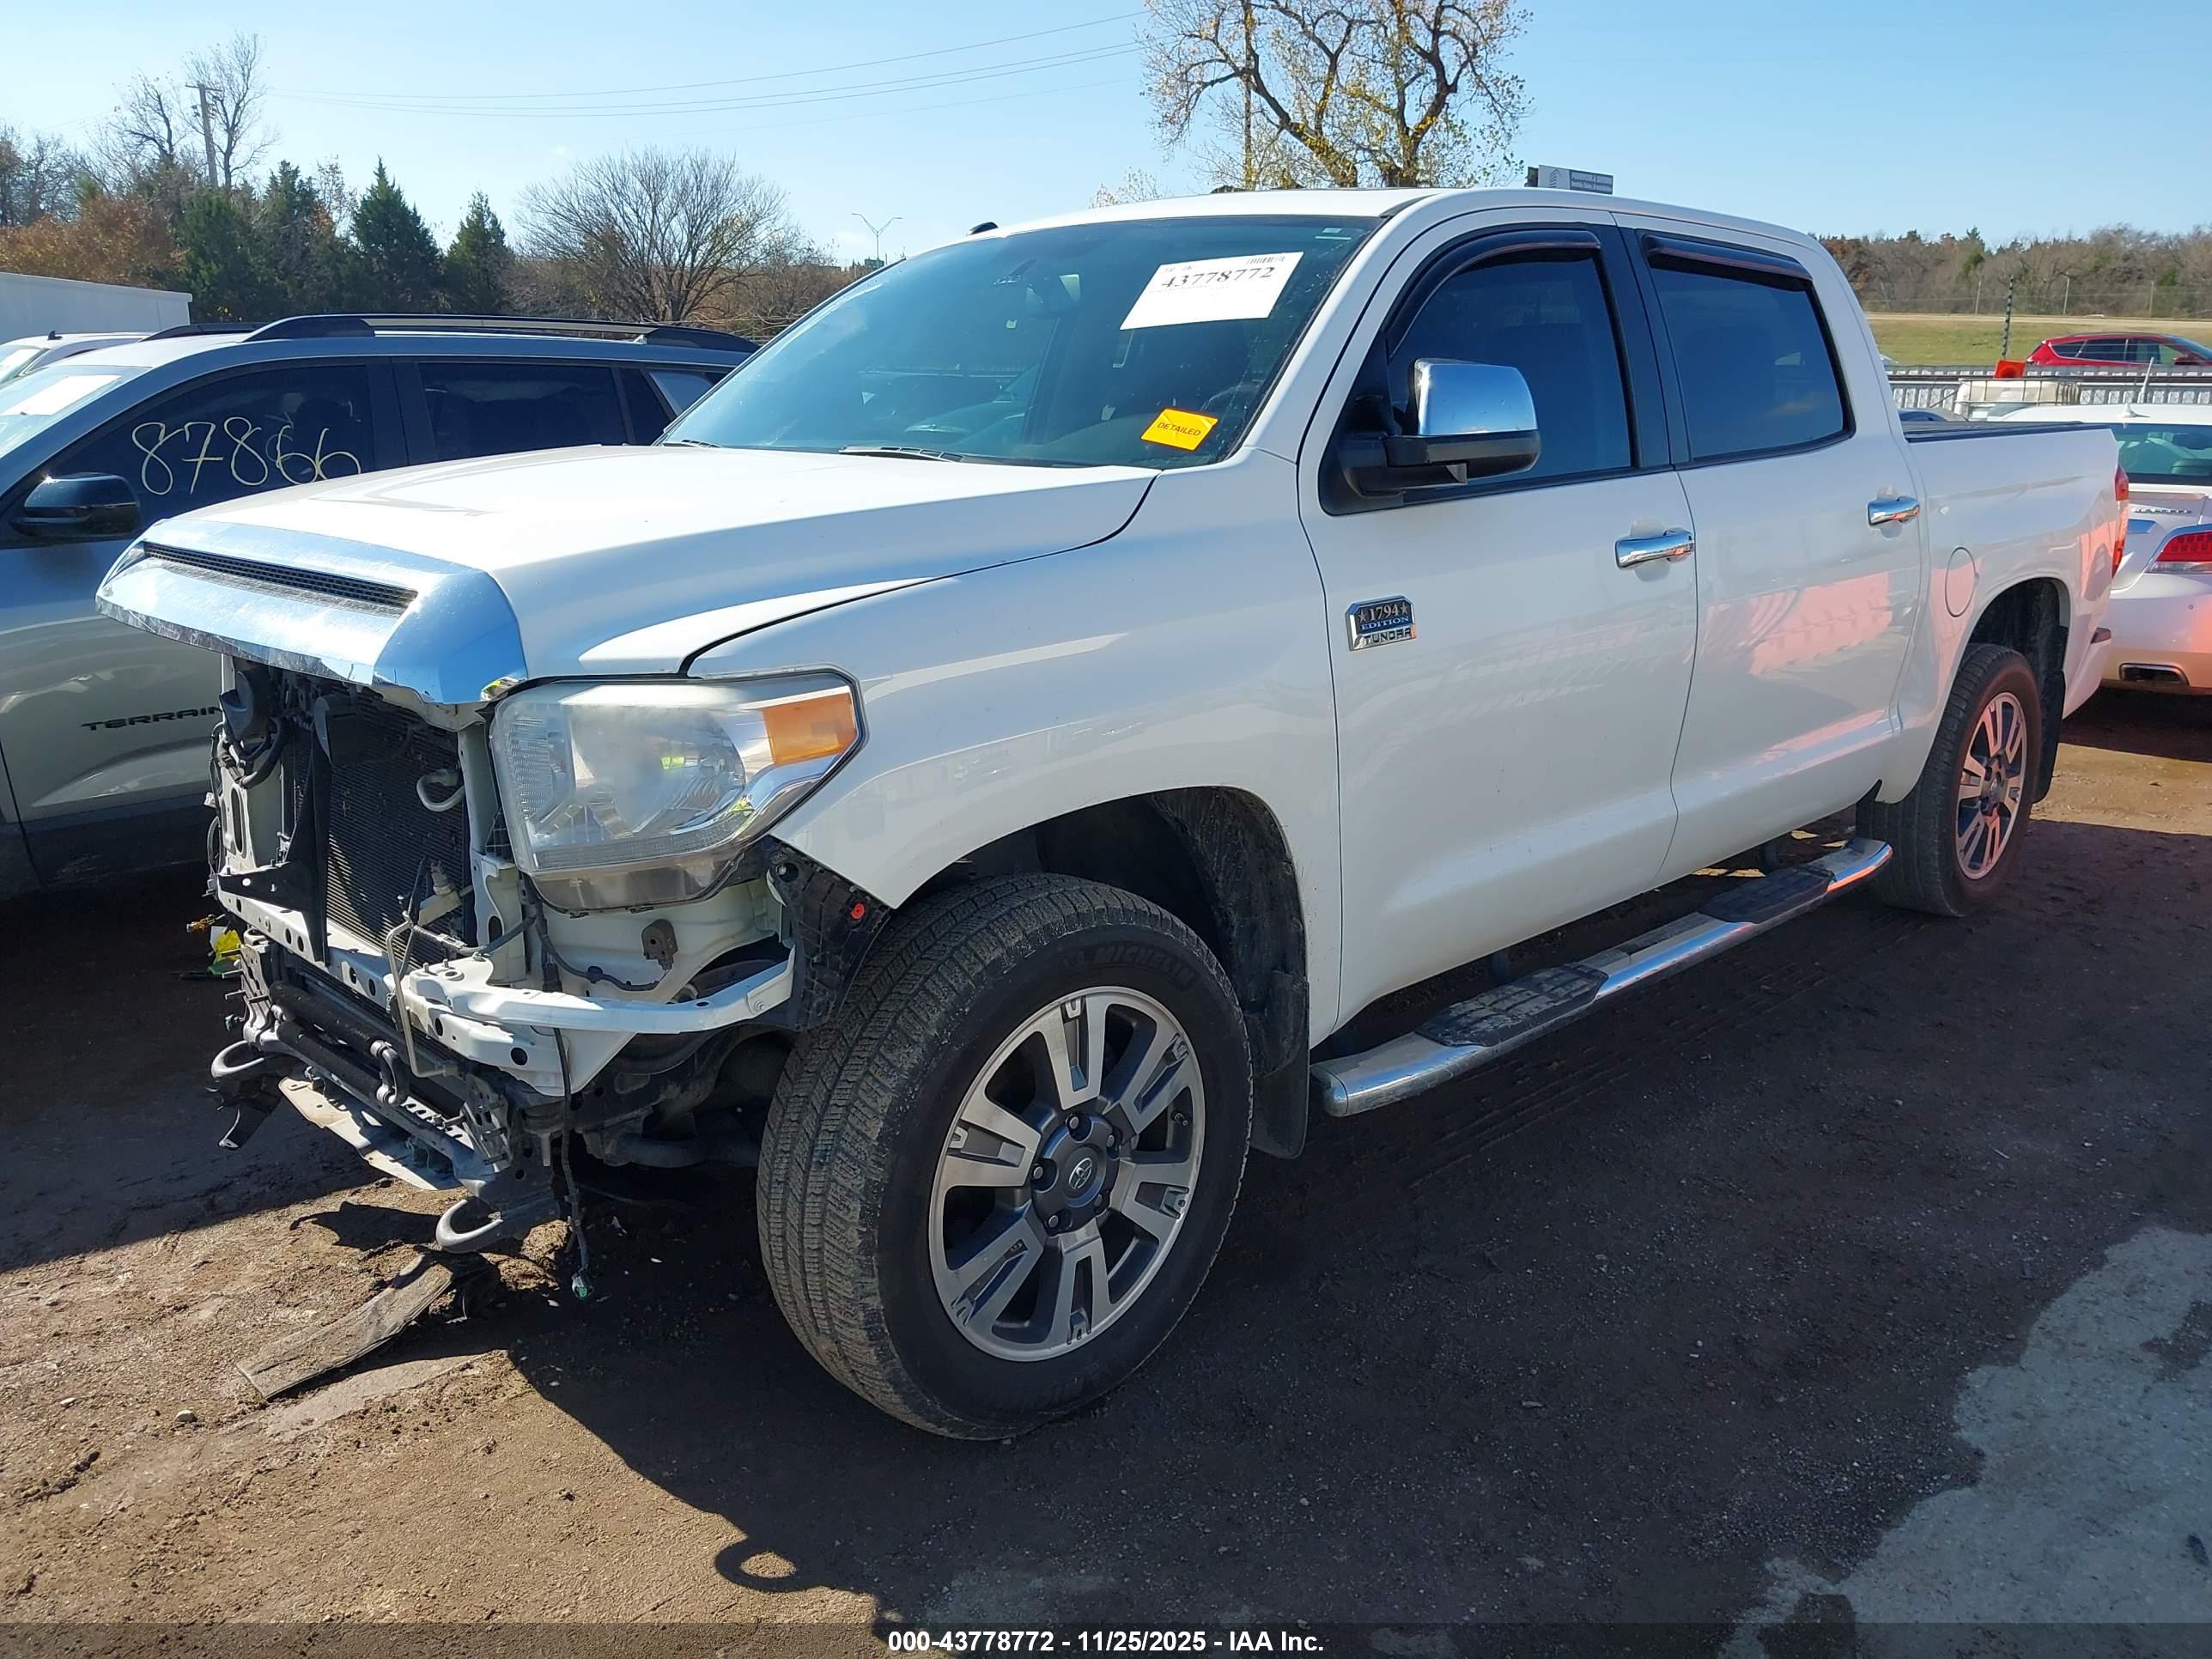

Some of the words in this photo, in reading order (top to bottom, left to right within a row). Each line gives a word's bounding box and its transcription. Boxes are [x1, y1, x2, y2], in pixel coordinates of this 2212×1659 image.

[1163, 267, 1275, 288] 43778772
[1157, 422, 1201, 436] DETAILED
[131, 416, 362, 495] 87866
[1369, 605, 1399, 621] 1794
[1361, 616, 1409, 630] EDITION
[1364, 628, 1412, 646] TUNDRA
[1095, 945, 1193, 988] MICHELIN
